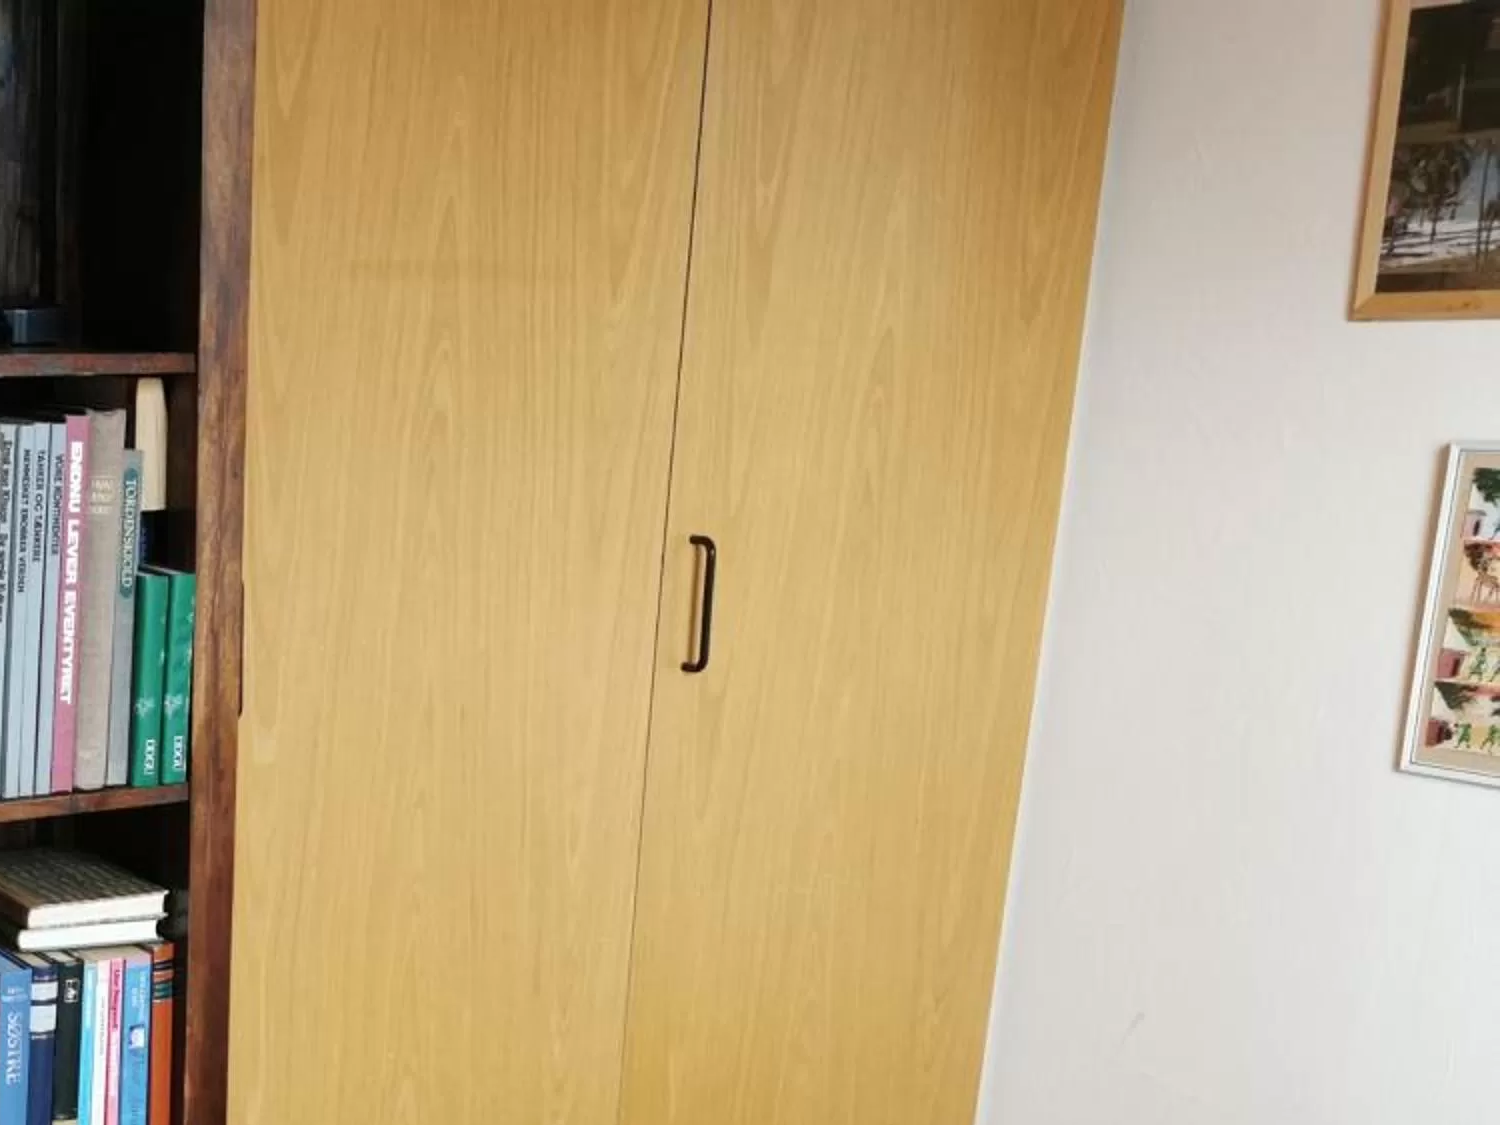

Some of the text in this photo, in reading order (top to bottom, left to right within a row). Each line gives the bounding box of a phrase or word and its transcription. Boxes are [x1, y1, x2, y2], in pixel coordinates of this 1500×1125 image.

[32, 493, 44, 512] OG
[60, 441, 84, 705] ENDNU LEVER EVENTYRET
[6, 1010, 22, 1085] SØSTRE
